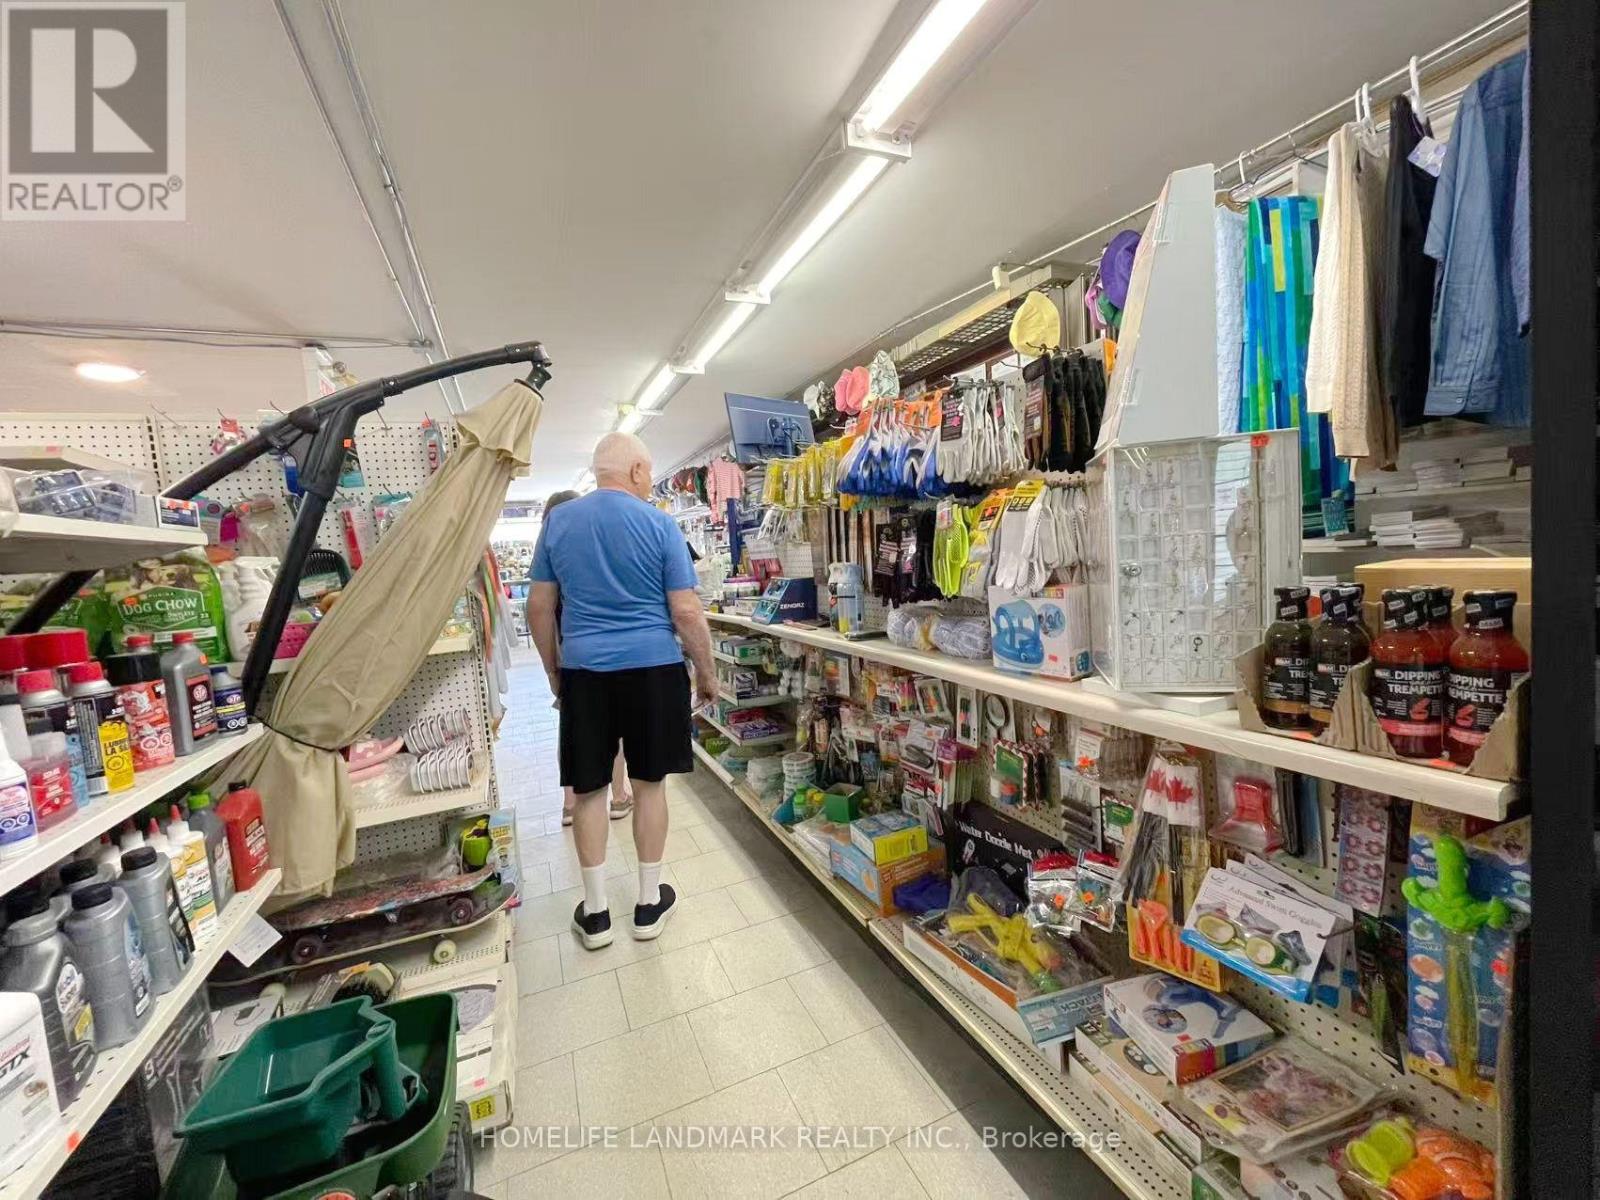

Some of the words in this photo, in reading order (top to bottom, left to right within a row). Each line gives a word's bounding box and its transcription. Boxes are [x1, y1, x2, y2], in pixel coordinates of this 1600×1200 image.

[122, 602, 153, 616] DOG
[155, 597, 198, 611] CHOW
[1387, 683, 1443, 695] TREMPETT
